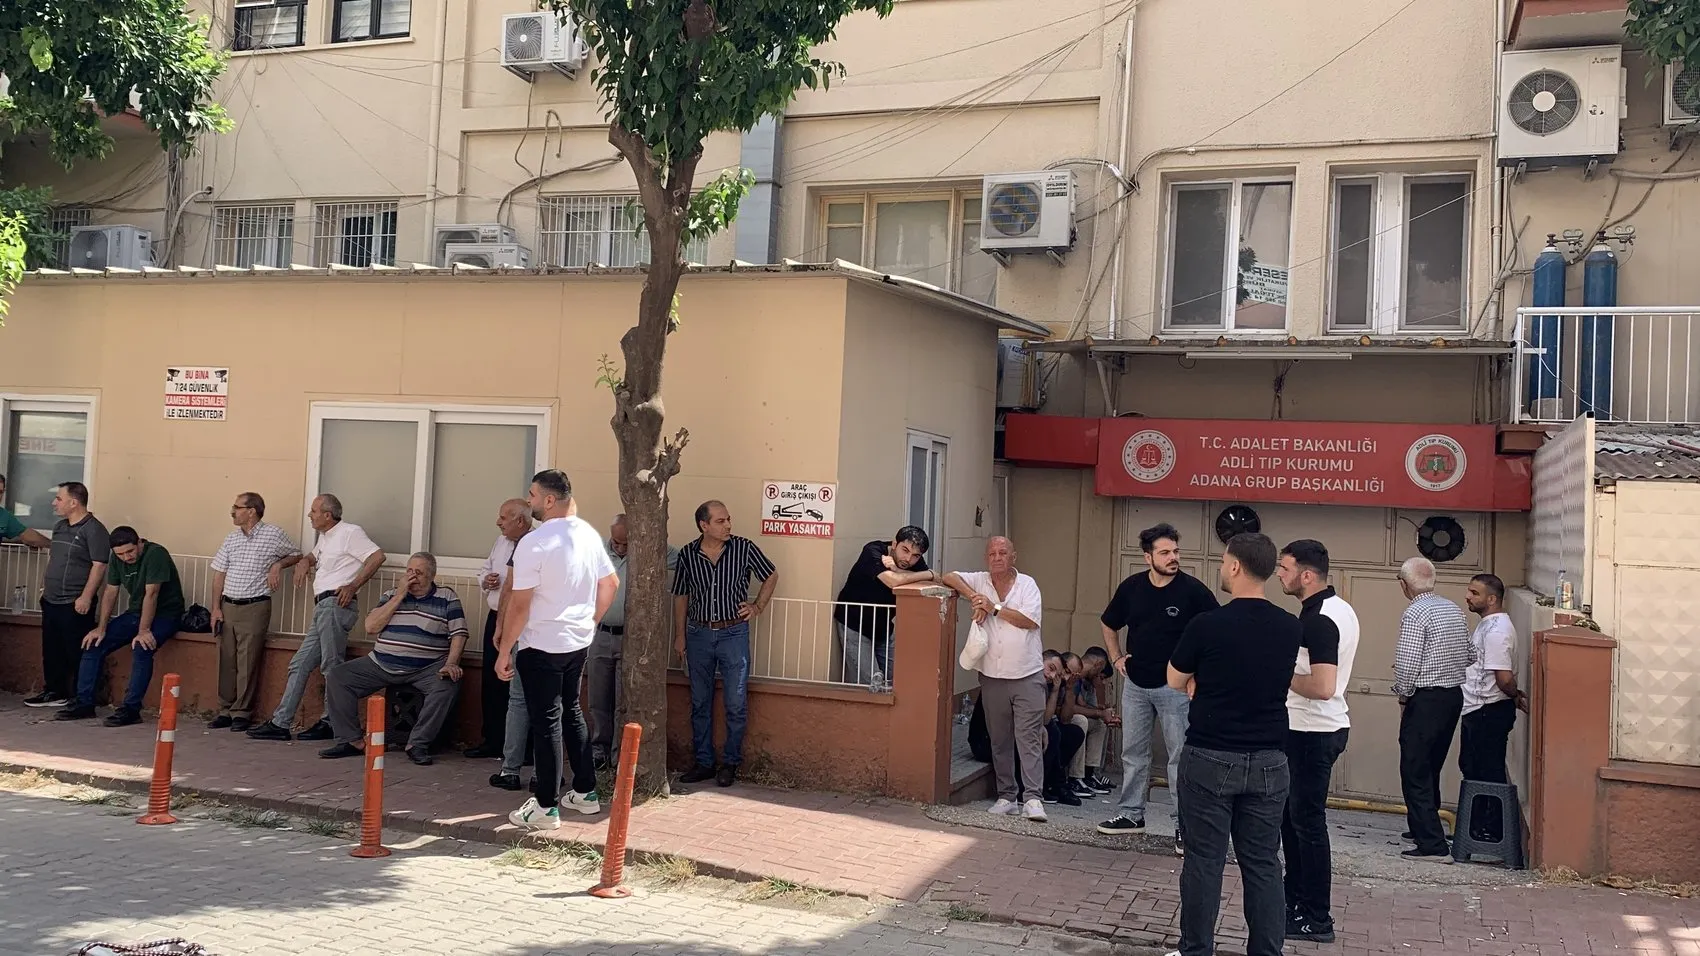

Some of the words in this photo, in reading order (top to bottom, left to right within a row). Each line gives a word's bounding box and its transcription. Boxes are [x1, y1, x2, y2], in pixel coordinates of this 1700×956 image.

[185, 370, 193, 379] BU
[165, 395, 190, 405] KAMERA
[1200, 436, 1226, 449] T.C.
[1230, 437, 1290, 451] ADALET
[1293, 437, 1377, 453] BAKANLIĞI
[1220, 454, 1254, 469] ADLİ
[1258, 457, 1282, 470] TIP
[1286, 458, 1354, 472] KURUMU
[791, 484, 807, 492] ARAÇ
[1189, 474, 1241, 487] ADANA
[1245, 475, 1287, 489] GRUP
[1291, 477, 1384, 493] BAŞKANLIĞI
[798, 492, 817, 501] ÇIKIŞI
[763, 521, 786, 533] PARK
[789, 523, 831, 535] YASAKTIR
